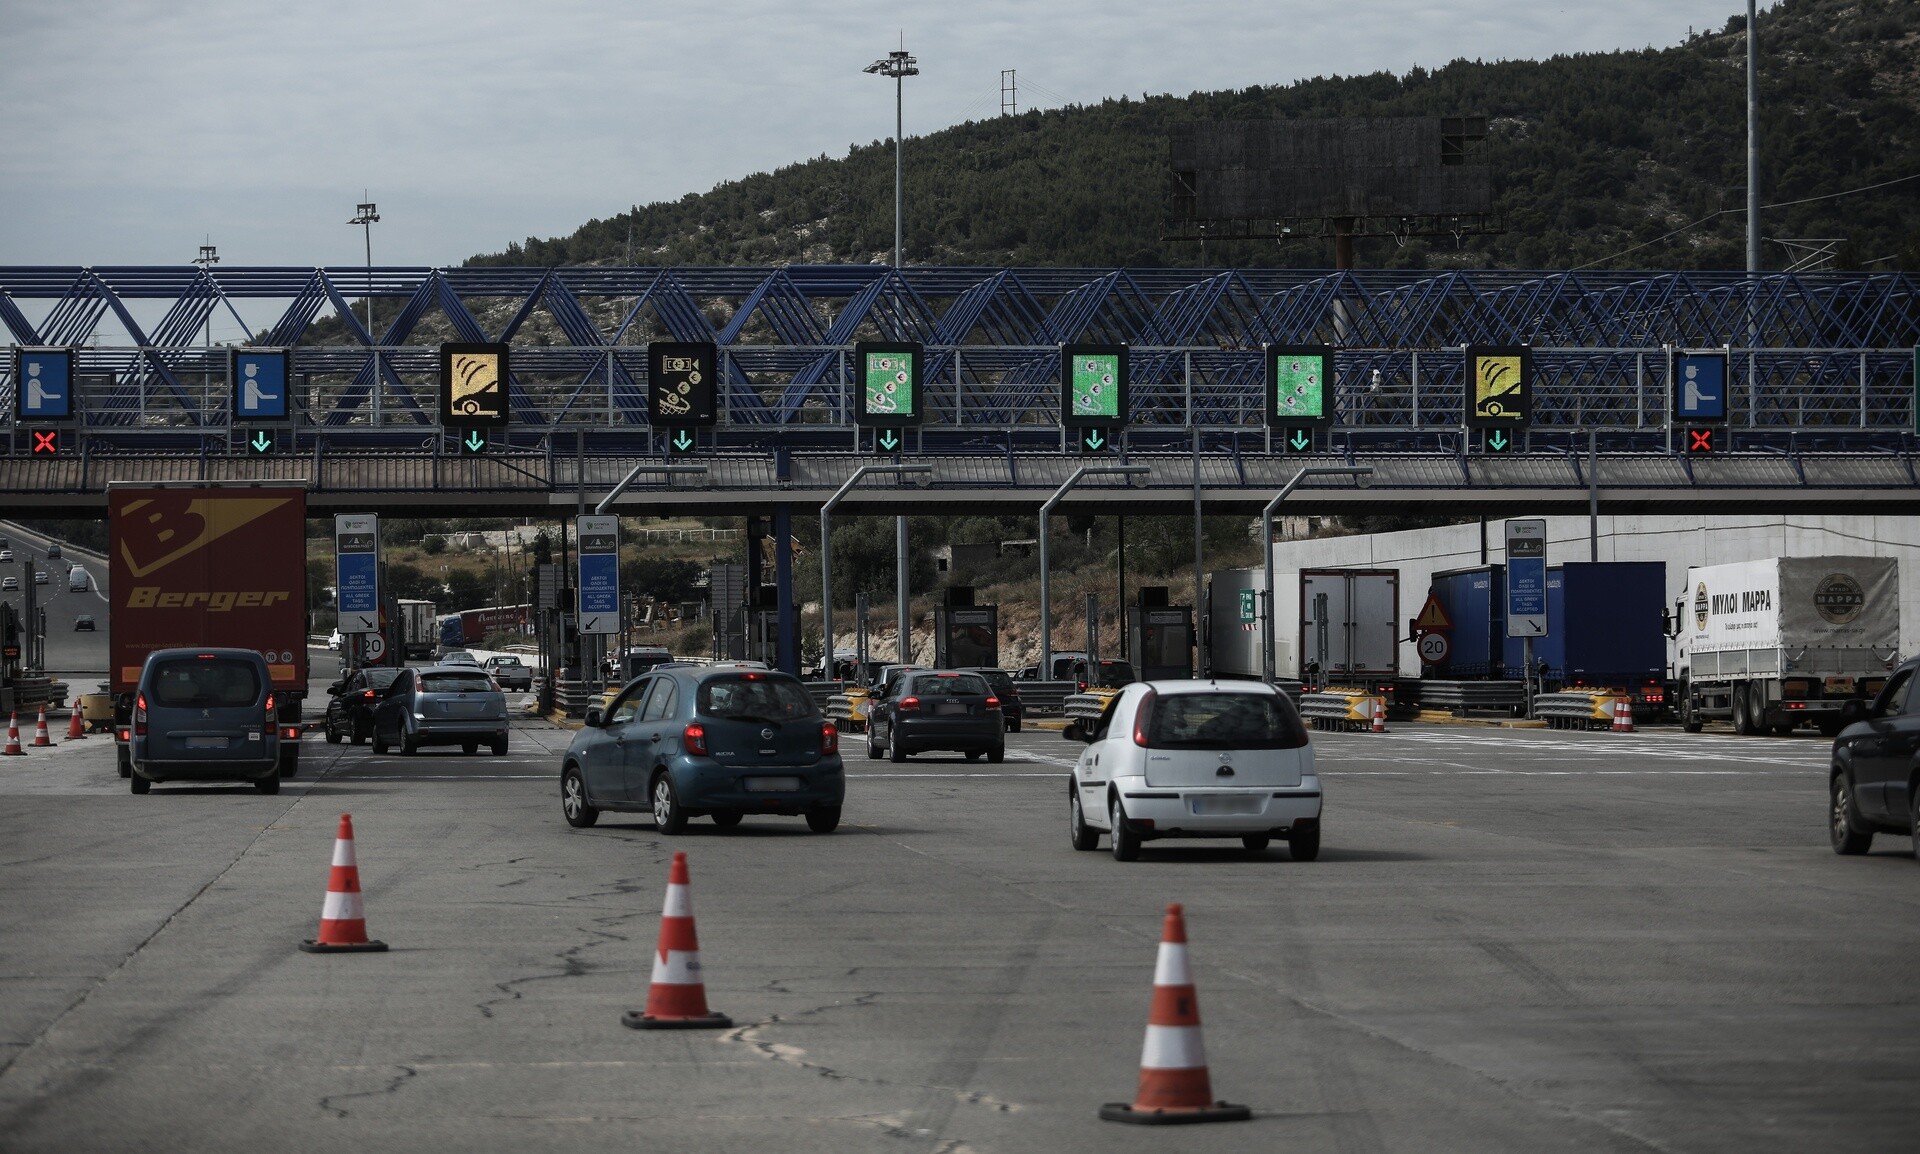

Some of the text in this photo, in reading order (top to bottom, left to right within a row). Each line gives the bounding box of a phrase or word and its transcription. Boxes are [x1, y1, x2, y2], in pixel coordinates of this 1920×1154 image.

[126, 587, 290, 612] Berger
[1712, 590, 1771, 615] ΜΥΛΟΙ ΜΑΡΡΑ
[1817, 595, 1862, 604] ΜΑΡΡΑ
[1424, 641, 1444, 654] 20
[283, 653, 291, 661] 80
